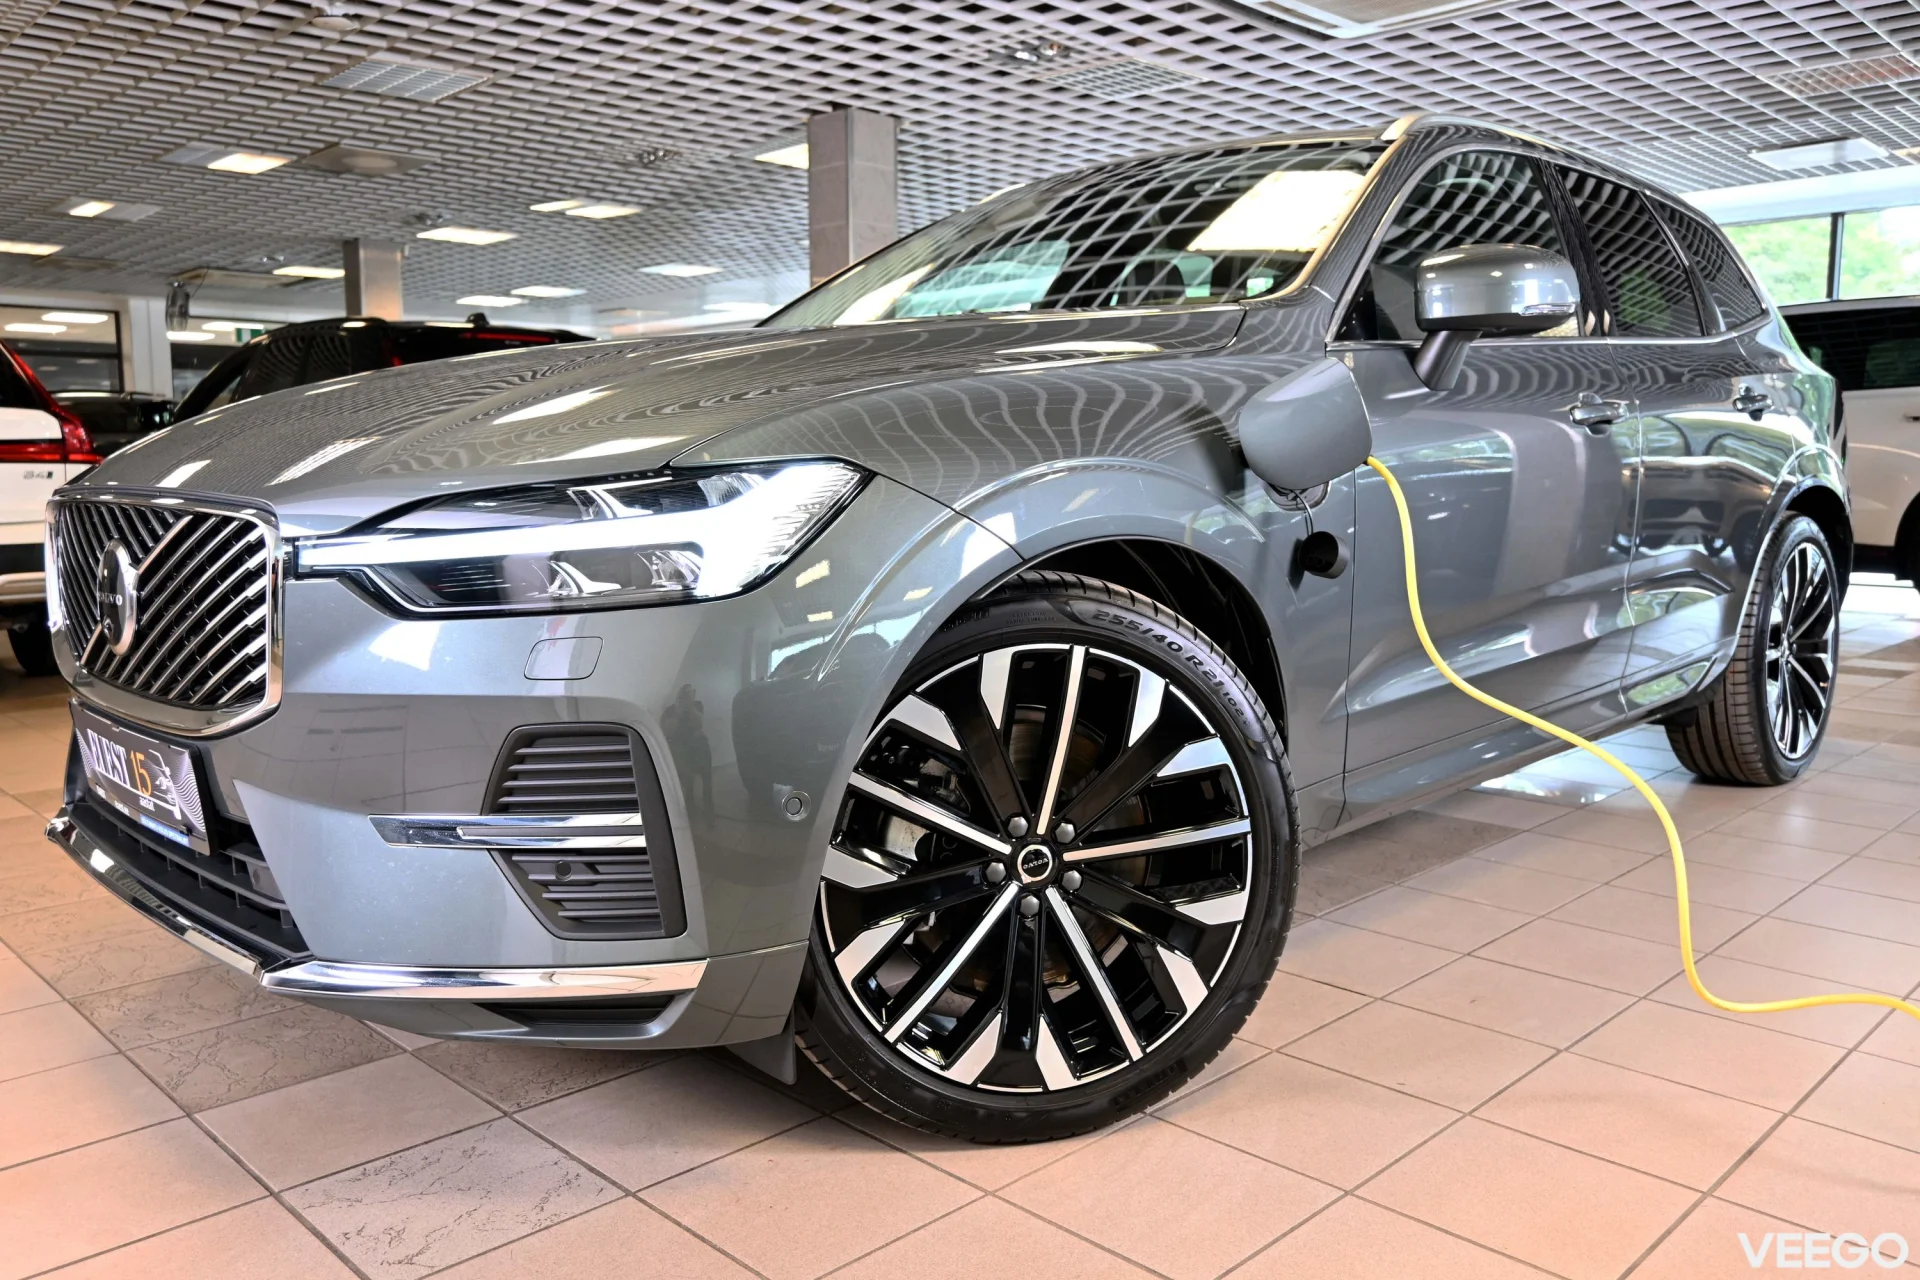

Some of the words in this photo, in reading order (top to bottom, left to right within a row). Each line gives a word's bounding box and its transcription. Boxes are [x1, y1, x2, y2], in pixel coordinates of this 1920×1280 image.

[1092, 609, 1184, 653] 255/40
[1185, 654, 1225, 688] R21
[130, 750, 152, 797] 15
